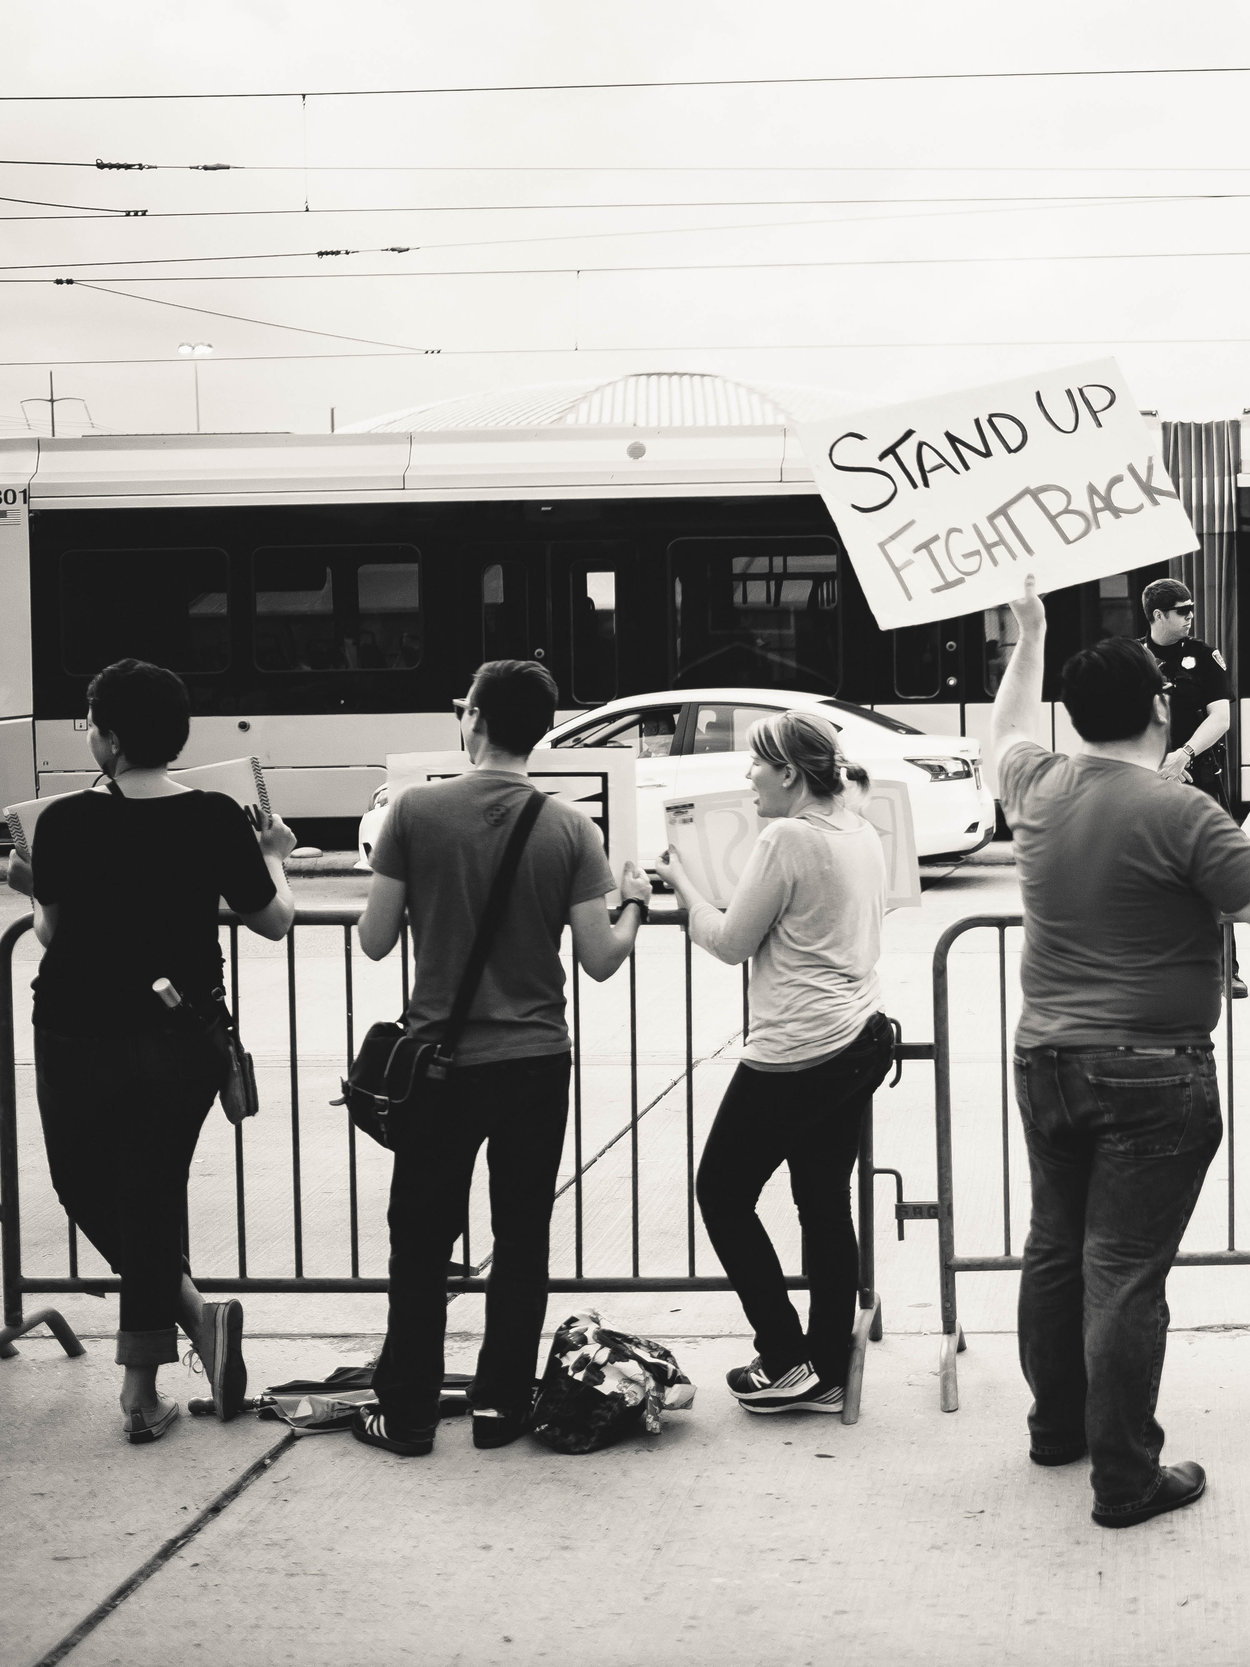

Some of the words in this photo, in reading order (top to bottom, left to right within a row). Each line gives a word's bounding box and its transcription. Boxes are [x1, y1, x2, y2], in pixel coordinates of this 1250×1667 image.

[0, 488, 28, 505] 01
[828, 412, 1029, 514] STAND
[1035, 383, 1117, 435] UP
[877, 486, 1036, 602] FIGHT
[1027, 455, 1180, 546] BACK
